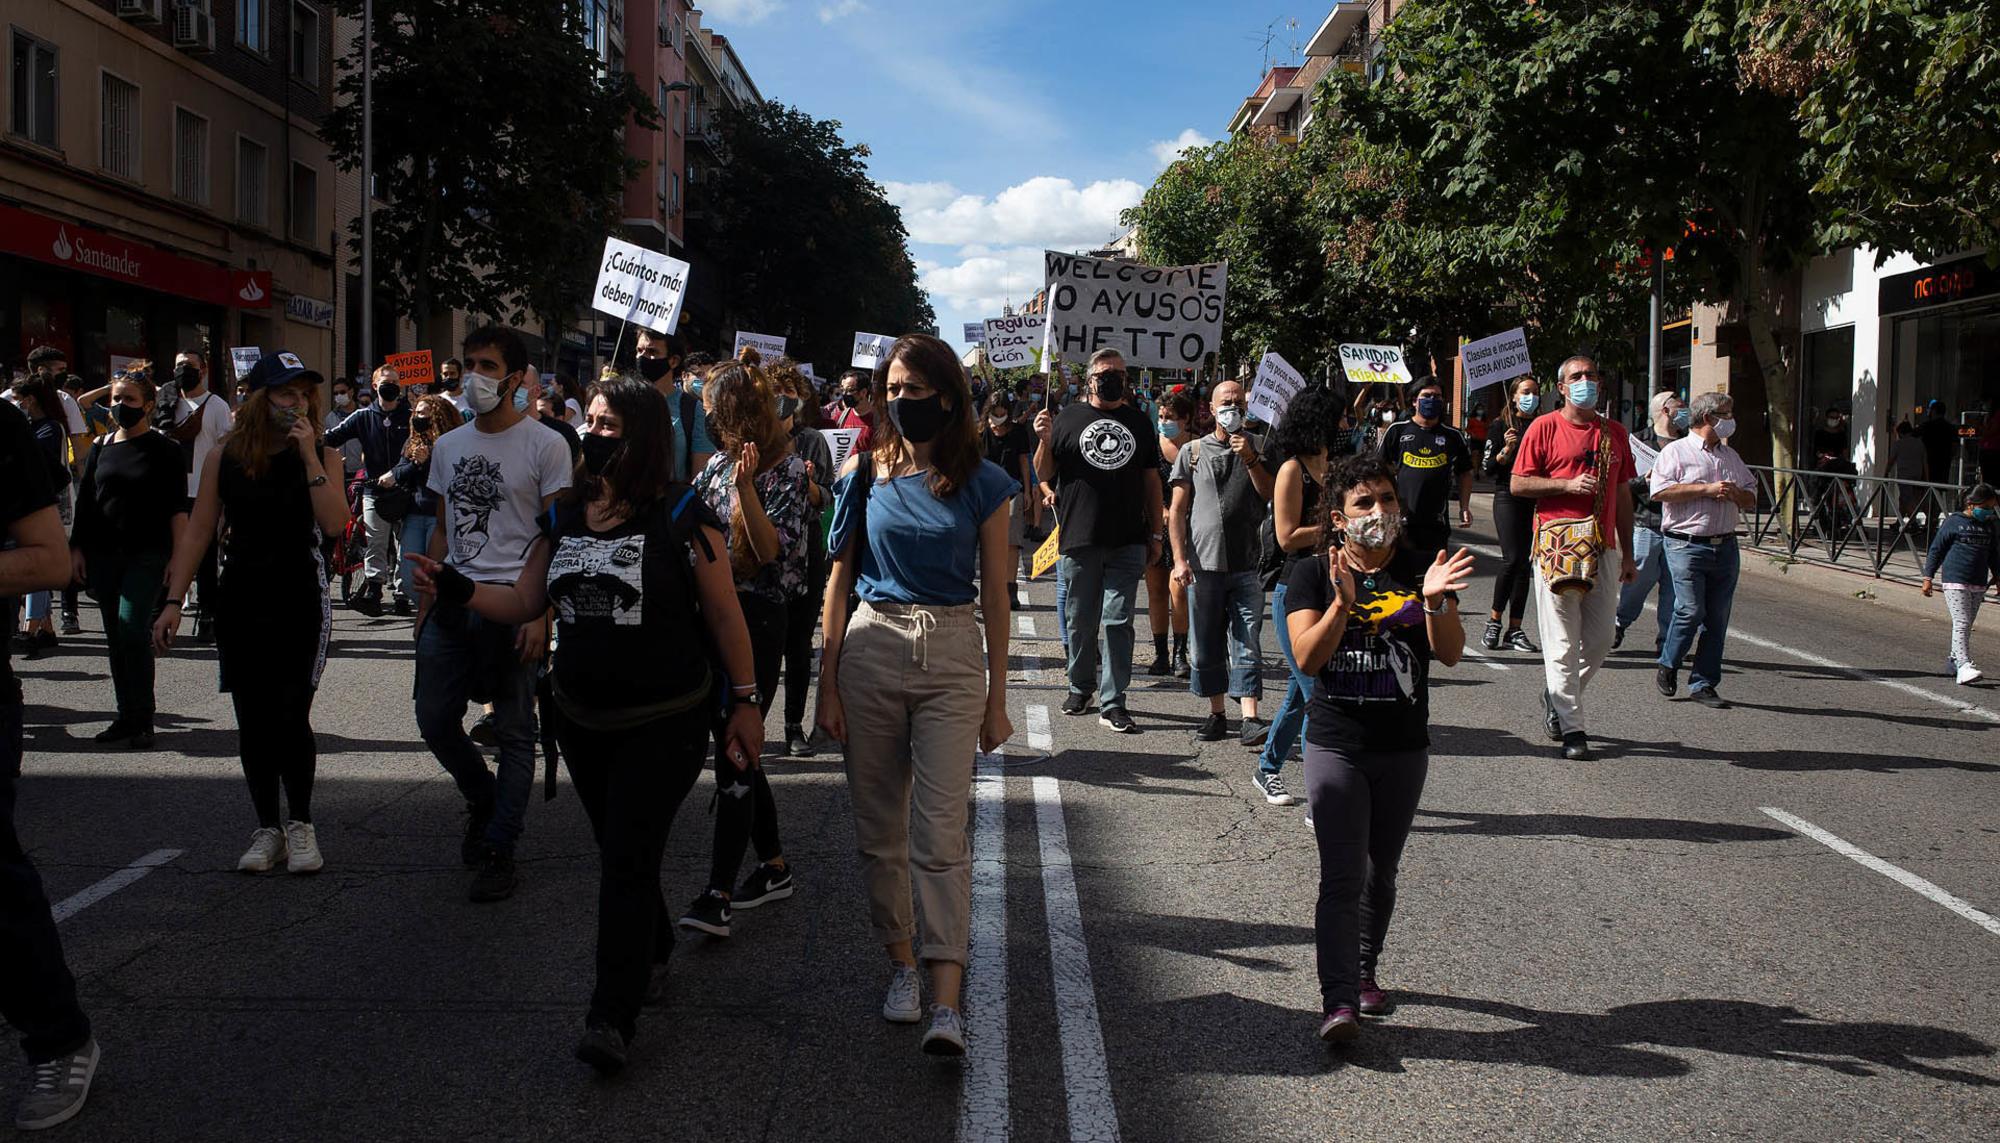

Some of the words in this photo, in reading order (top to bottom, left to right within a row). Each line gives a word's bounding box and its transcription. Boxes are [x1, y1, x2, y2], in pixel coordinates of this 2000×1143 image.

[75, 237, 142, 278] Santander
[605, 251, 659, 283] ¿Cuántos
[659, 272, 682, 293] más
[1046, 252, 1218, 290] WELCOME
[601, 281, 634, 307] deben
[635, 295, 673, 321] morir?
[987, 317, 1047, 333] regula-
[988, 333, 1034, 349] riza-
[992, 348, 1024, 363] ción
[1340, 345, 1399, 364] SANIDAD
[1466, 346, 1493, 363] Clasista
[1492, 346, 1498, 355] e
[1265, 356, 1275, 373] Hay
[1273, 365, 1288, 382] pocos
[1469, 363, 1493, 379] FUERA
[1493, 355, 1516, 372] AYUSO
[1516, 351, 1529, 364] YA!
[1258, 374, 1265, 387] y
[1263, 377, 1277, 391] mal
[1252, 391, 1260, 404] y
[1257, 394, 1271, 407] mal
[1084, 422, 1131, 453] BULTACO
[1405, 453, 1447, 467] CRISTAL
[615, 547, 640, 560] STOP
[1365, 636, 1376, 649] LE
[1373, 653, 1387, 671] LA
